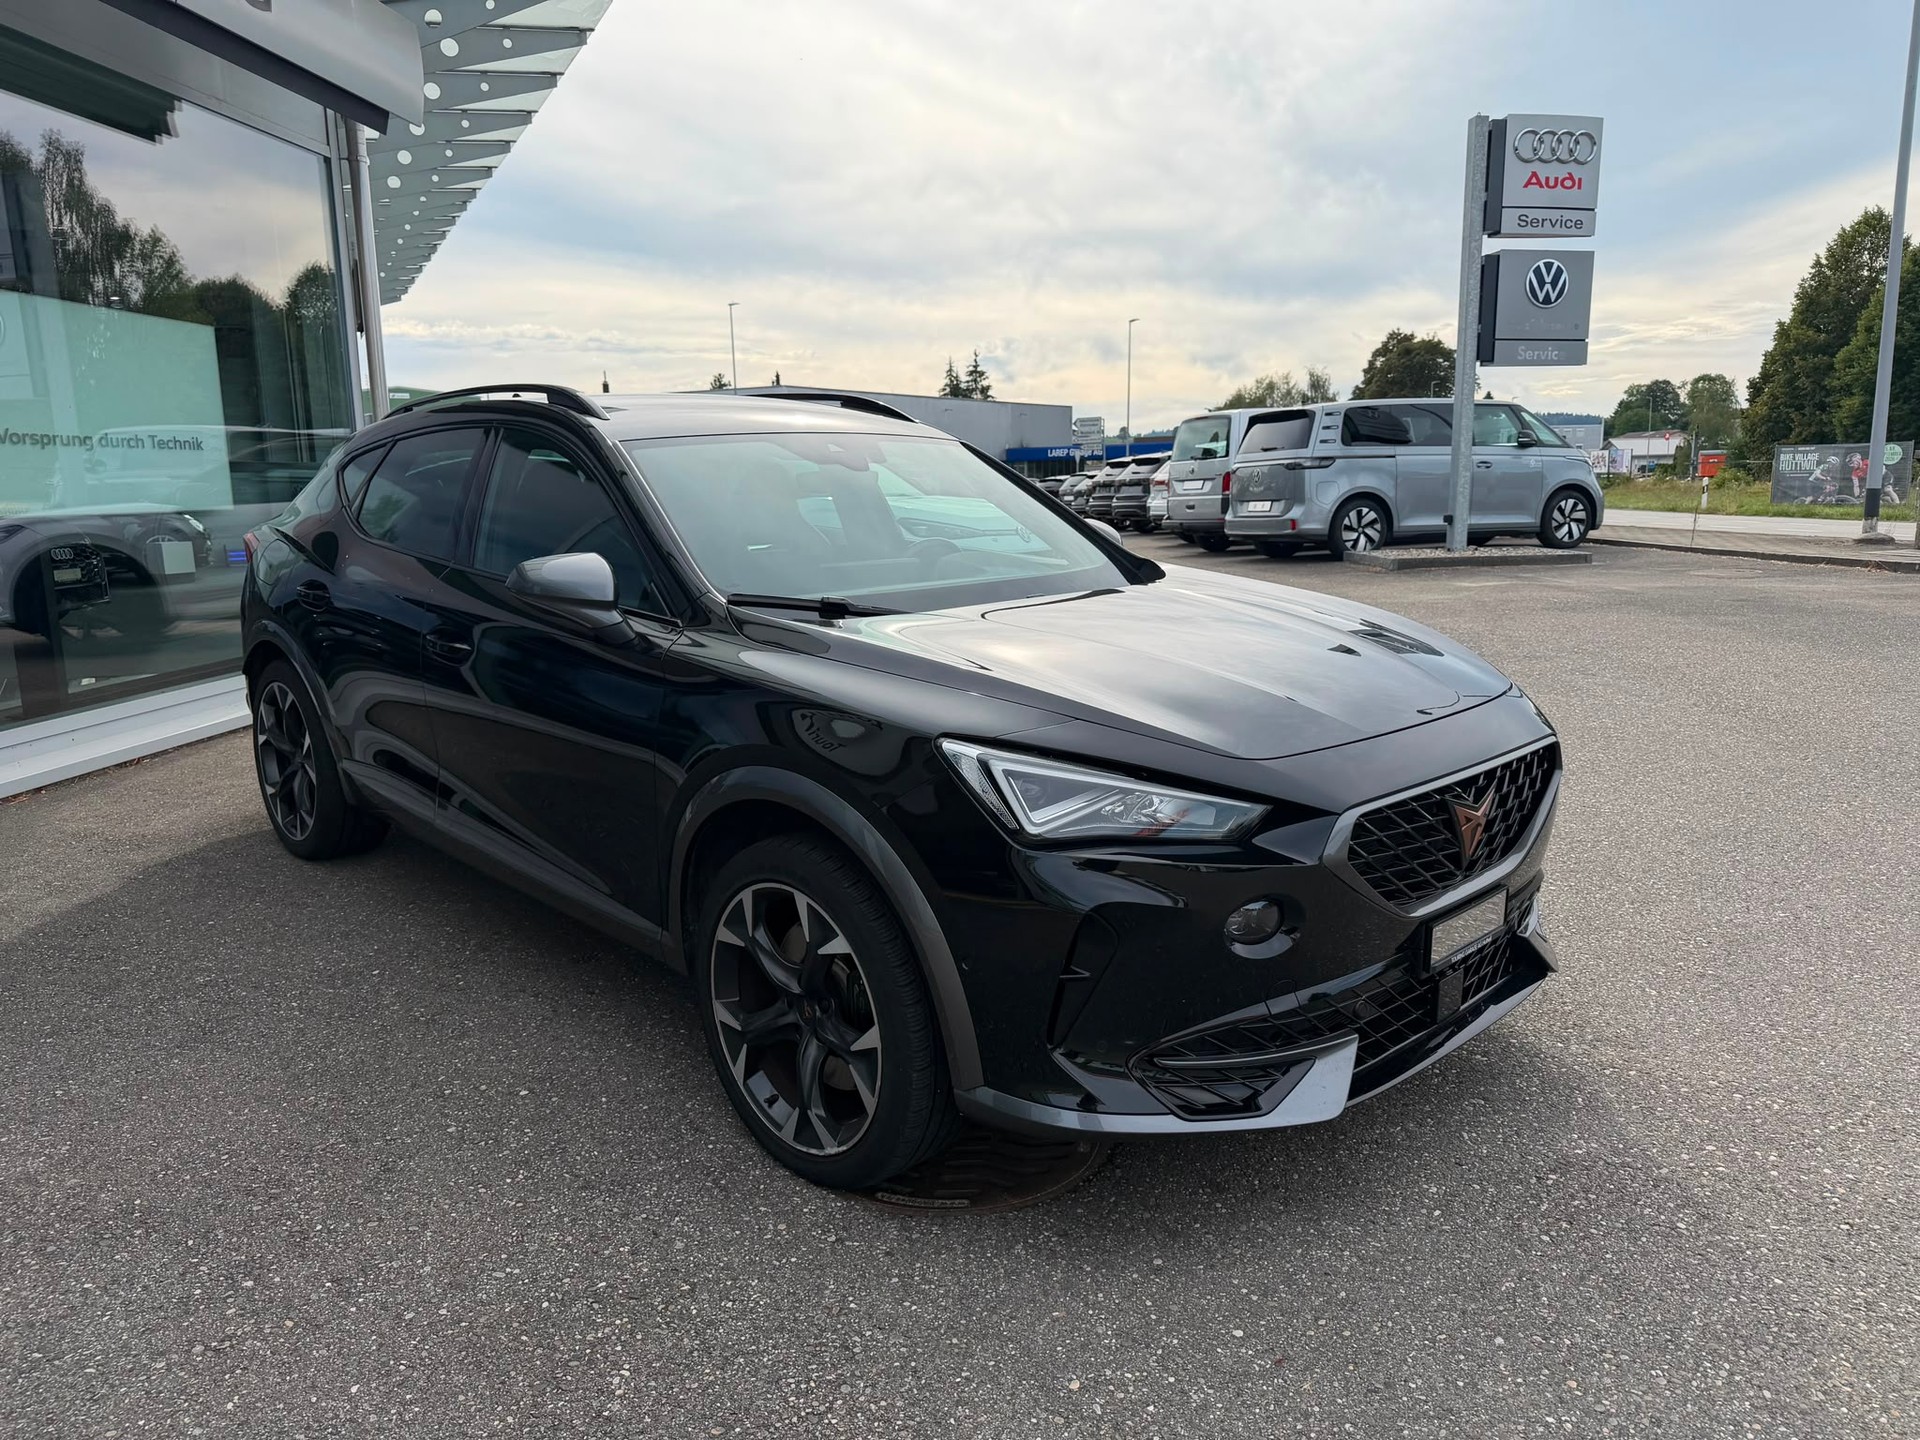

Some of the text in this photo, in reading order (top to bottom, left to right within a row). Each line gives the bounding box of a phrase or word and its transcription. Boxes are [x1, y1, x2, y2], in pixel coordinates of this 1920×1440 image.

[1522, 171, 1583, 190] Audi
[1517, 214, 1584, 230] Service
[0, 428, 204, 451] Vorsprung durch Technik
[1047, 449, 1068, 457] LAREP
[1069, 448, 1092, 457] Gage
[1780, 452, 1820, 461] BIKE VILLAGE
